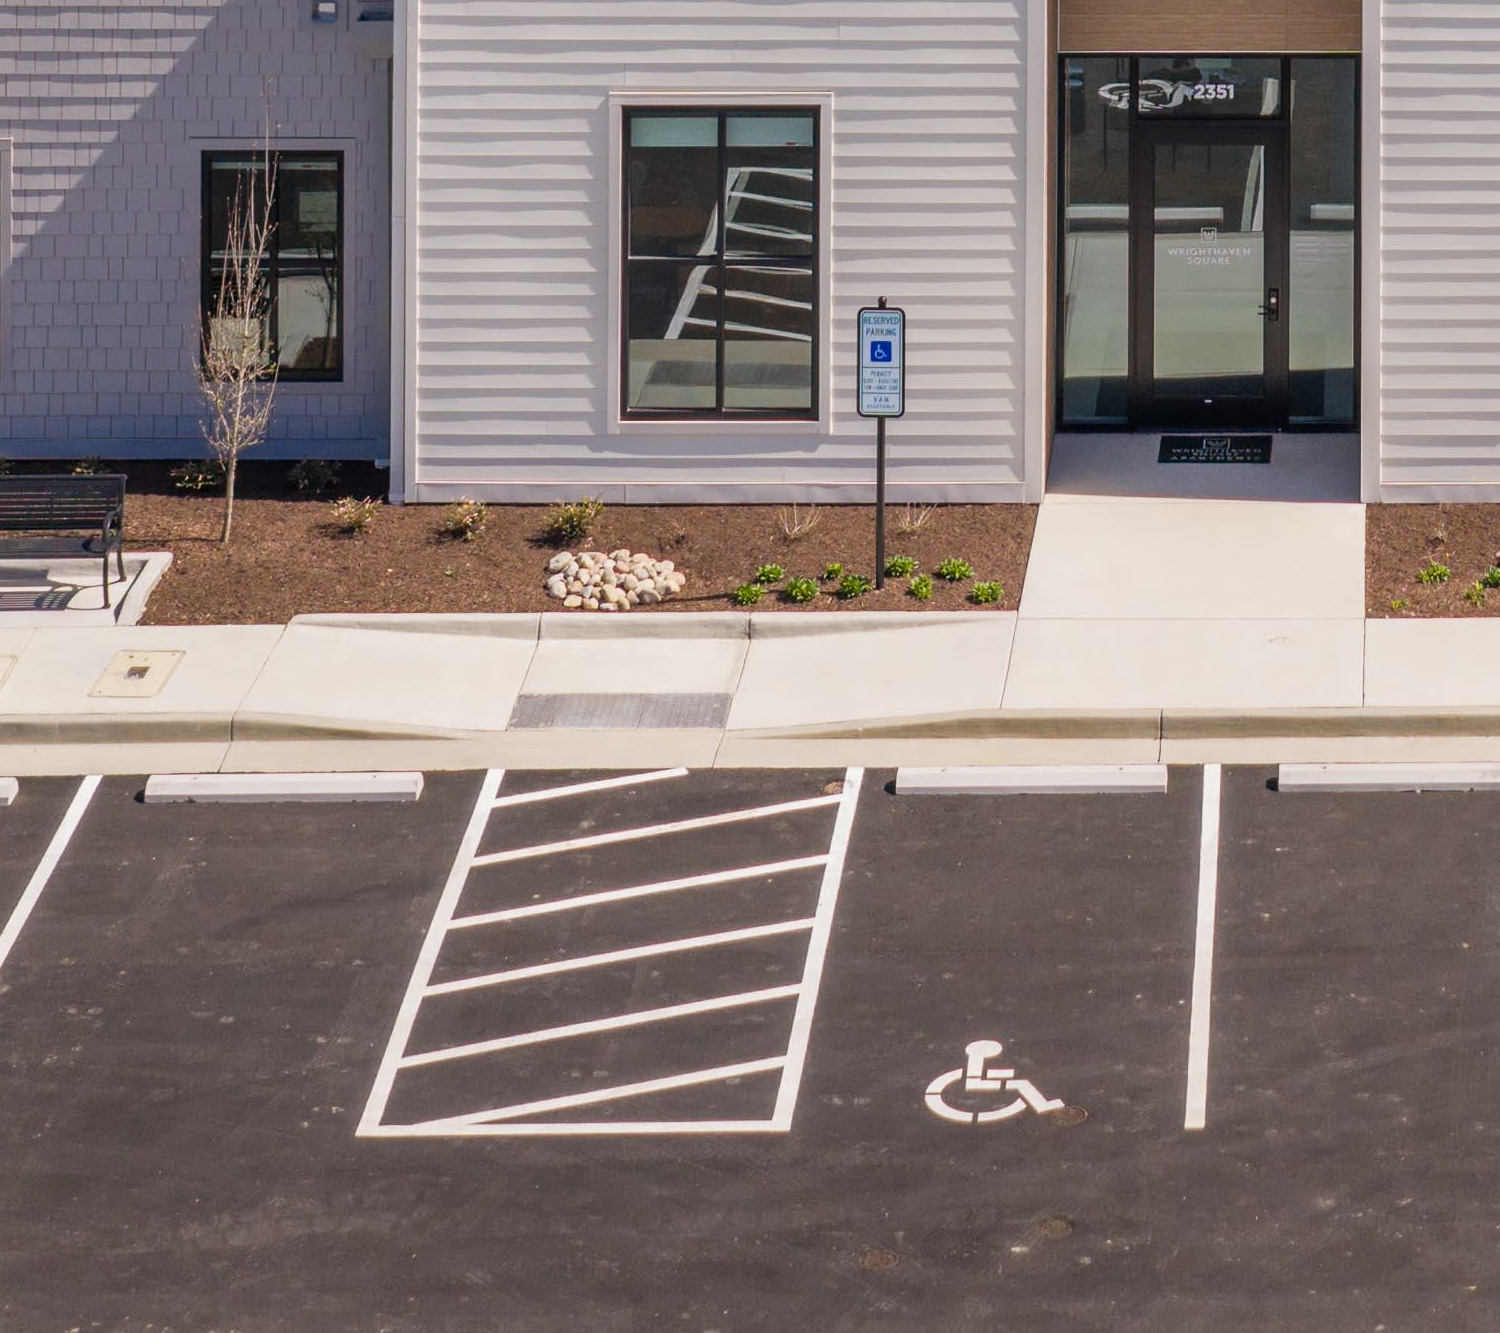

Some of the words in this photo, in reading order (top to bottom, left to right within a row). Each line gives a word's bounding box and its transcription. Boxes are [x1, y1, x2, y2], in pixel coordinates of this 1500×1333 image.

[1193, 84, 1235, 99] 2351
[1167, 247, 1252, 255] WRIGHTHAVEN
[1187, 256, 1232, 265] SQUARE
[863, 316, 899, 325] RESERVED
[866, 328, 897, 336] PARKING
